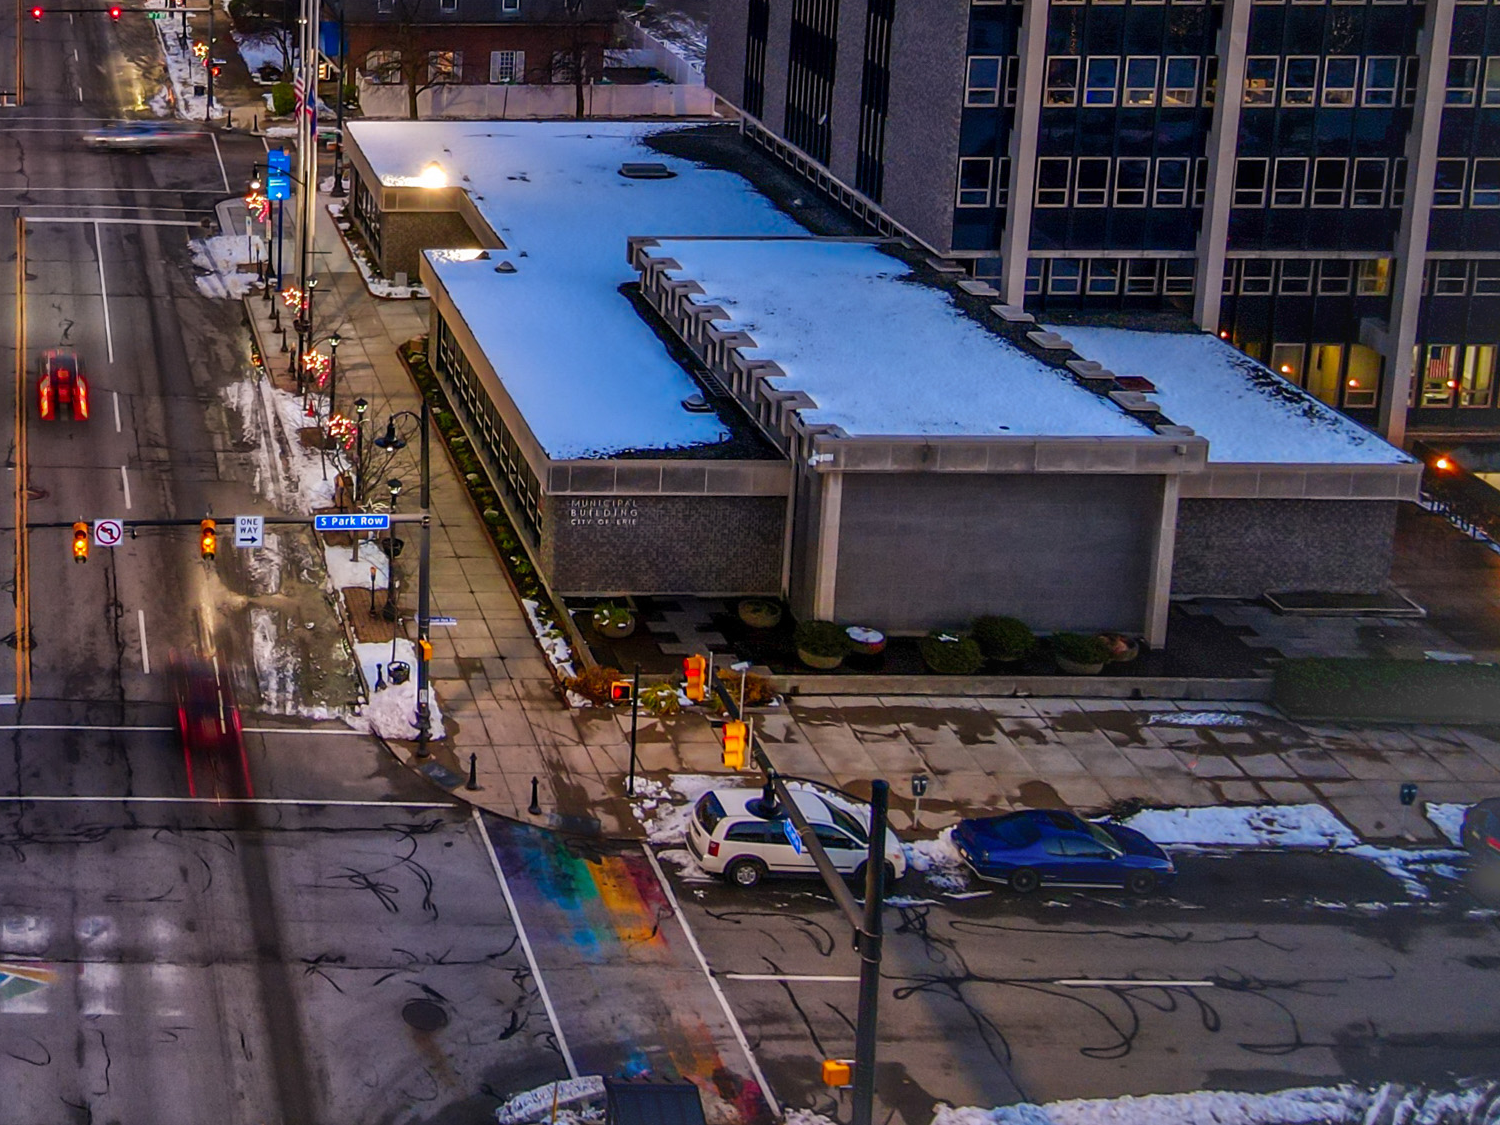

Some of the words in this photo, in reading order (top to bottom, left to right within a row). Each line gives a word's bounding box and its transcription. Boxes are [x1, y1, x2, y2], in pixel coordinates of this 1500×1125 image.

[571, 499, 637, 507] MUNICIPAL
[570, 509, 638, 517] BUILDING
[240, 518, 258, 526] ONE
[321, 517, 327, 526] S
[331, 517, 356, 526] Park
[360, 517, 384, 525] Row
